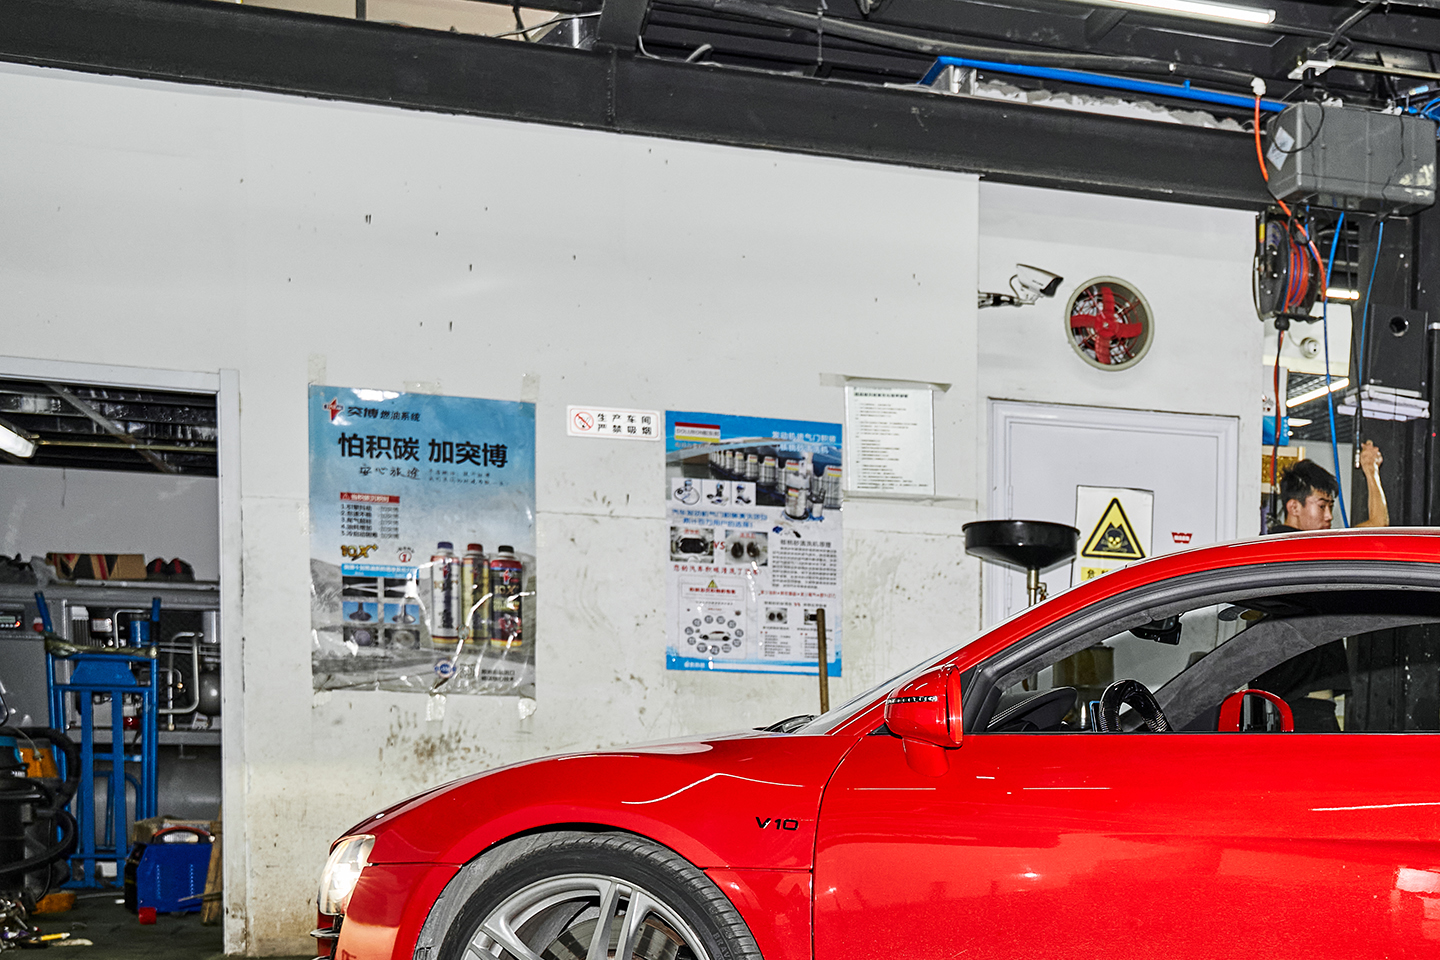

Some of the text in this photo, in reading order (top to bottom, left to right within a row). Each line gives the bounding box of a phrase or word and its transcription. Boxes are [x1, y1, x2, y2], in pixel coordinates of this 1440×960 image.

[597, 424, 652, 436] 严禁吸烟
[338, 432, 509, 468] 怕积碳 加突博
[714, 541, 725, 550] VS
[755, 816, 799, 831] V10
